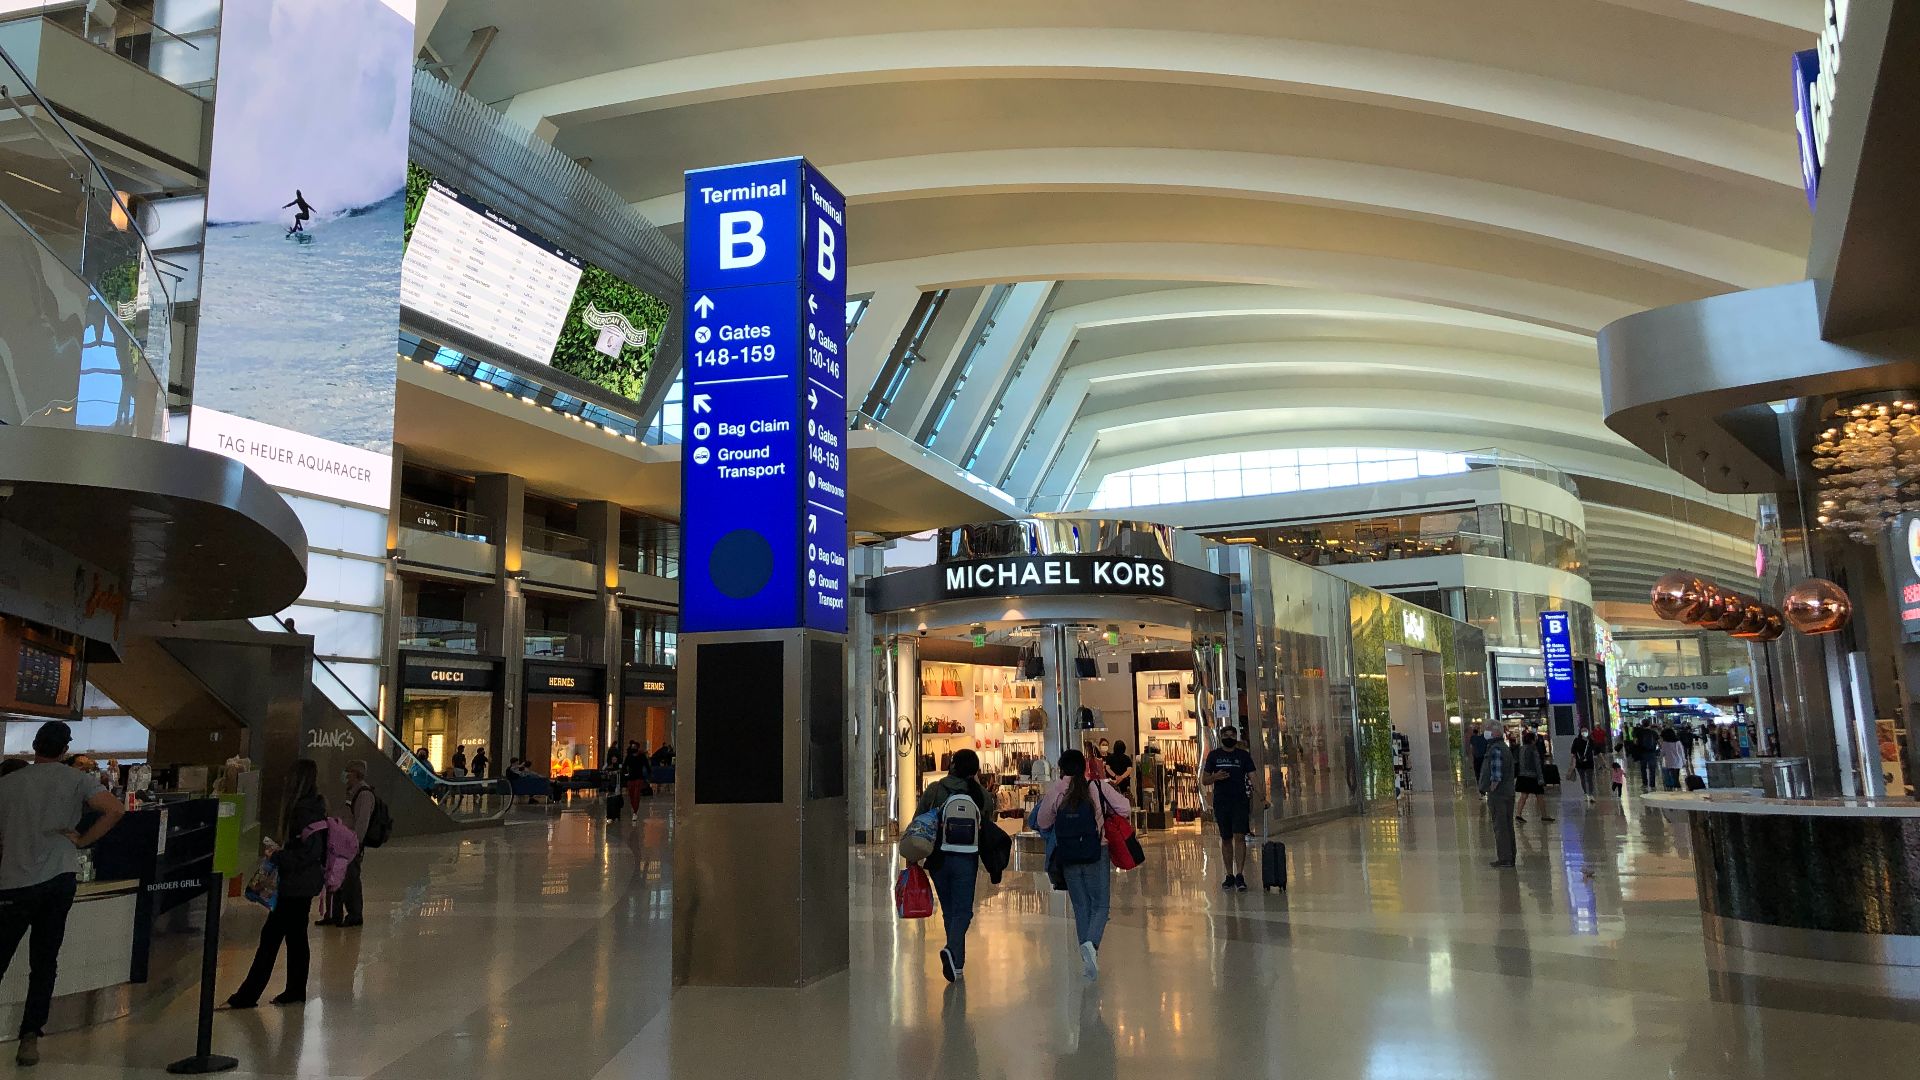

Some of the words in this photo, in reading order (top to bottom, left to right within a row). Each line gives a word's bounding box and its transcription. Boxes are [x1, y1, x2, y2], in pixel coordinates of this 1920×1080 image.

[432, 179, 458, 200] Departures
[701, 179, 786, 204] Terminal
[810, 184, 842, 226] Terminal
[719, 210, 767, 270] B
[817, 217, 836, 282] B
[588, 311, 619, 325] AMERICAN
[620, 322, 643, 343] EXPRESS
[718, 325, 771, 341] Gates
[818, 330, 838, 355] Gates
[694, 344, 776, 367] 148-159
[808, 347, 840, 379] 130-146
[718, 422, 746, 437] Bag
[750, 418, 790, 434] Claim
[818, 424, 838, 448] Gates
[218, 433, 245, 453] TAG
[250, 441, 293, 465] HEUER
[297, 453, 372, 483] AQUARACER
[718, 445, 770, 461] Ground
[808, 444, 840, 472] 148-159
[718, 463, 786, 479] Transport
[818, 476, 845, 498] Restrooms
[818, 547, 830, 566] Bag
[830, 551, 845, 567] Claim
[818, 574, 838, 591] Ground
[946, 561, 1080, 590] MICHAEL
[1093, 561, 1165, 587] KORS
[818, 592, 844, 610] Transport
[1549, 620, 1562, 634] B
[431, 670, 464, 682] GUCCI
[1668, 682, 1708, 691] 150-159
[461, 738, 485, 746] GUCCI
[147, 881, 179, 892] BORDER
[180, 878, 202, 888] GRILL
